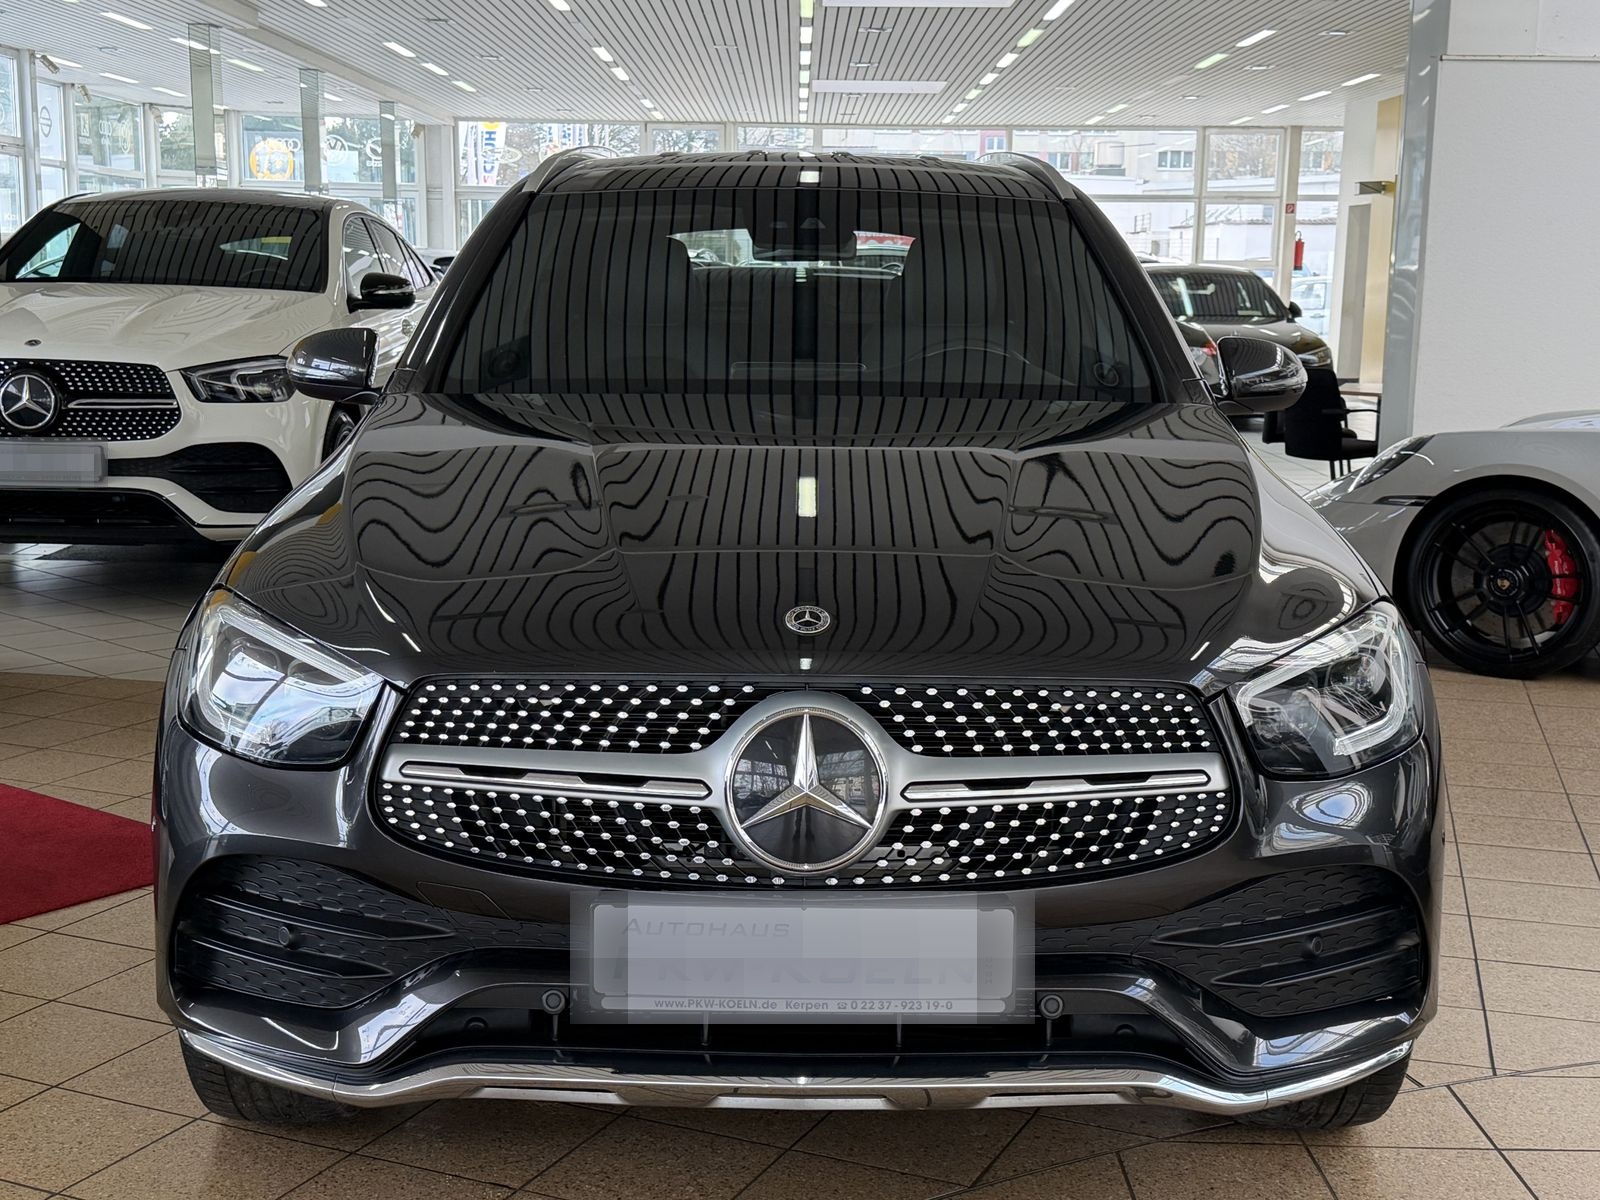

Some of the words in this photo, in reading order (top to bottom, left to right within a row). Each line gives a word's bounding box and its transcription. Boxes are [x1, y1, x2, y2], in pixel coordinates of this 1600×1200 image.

[621, 918, 791, 938] AUTOHAUS
[654, 998, 778, 1010] www.PKW-KOELN.de
[785, 1000, 829, 1012] Kerpen
